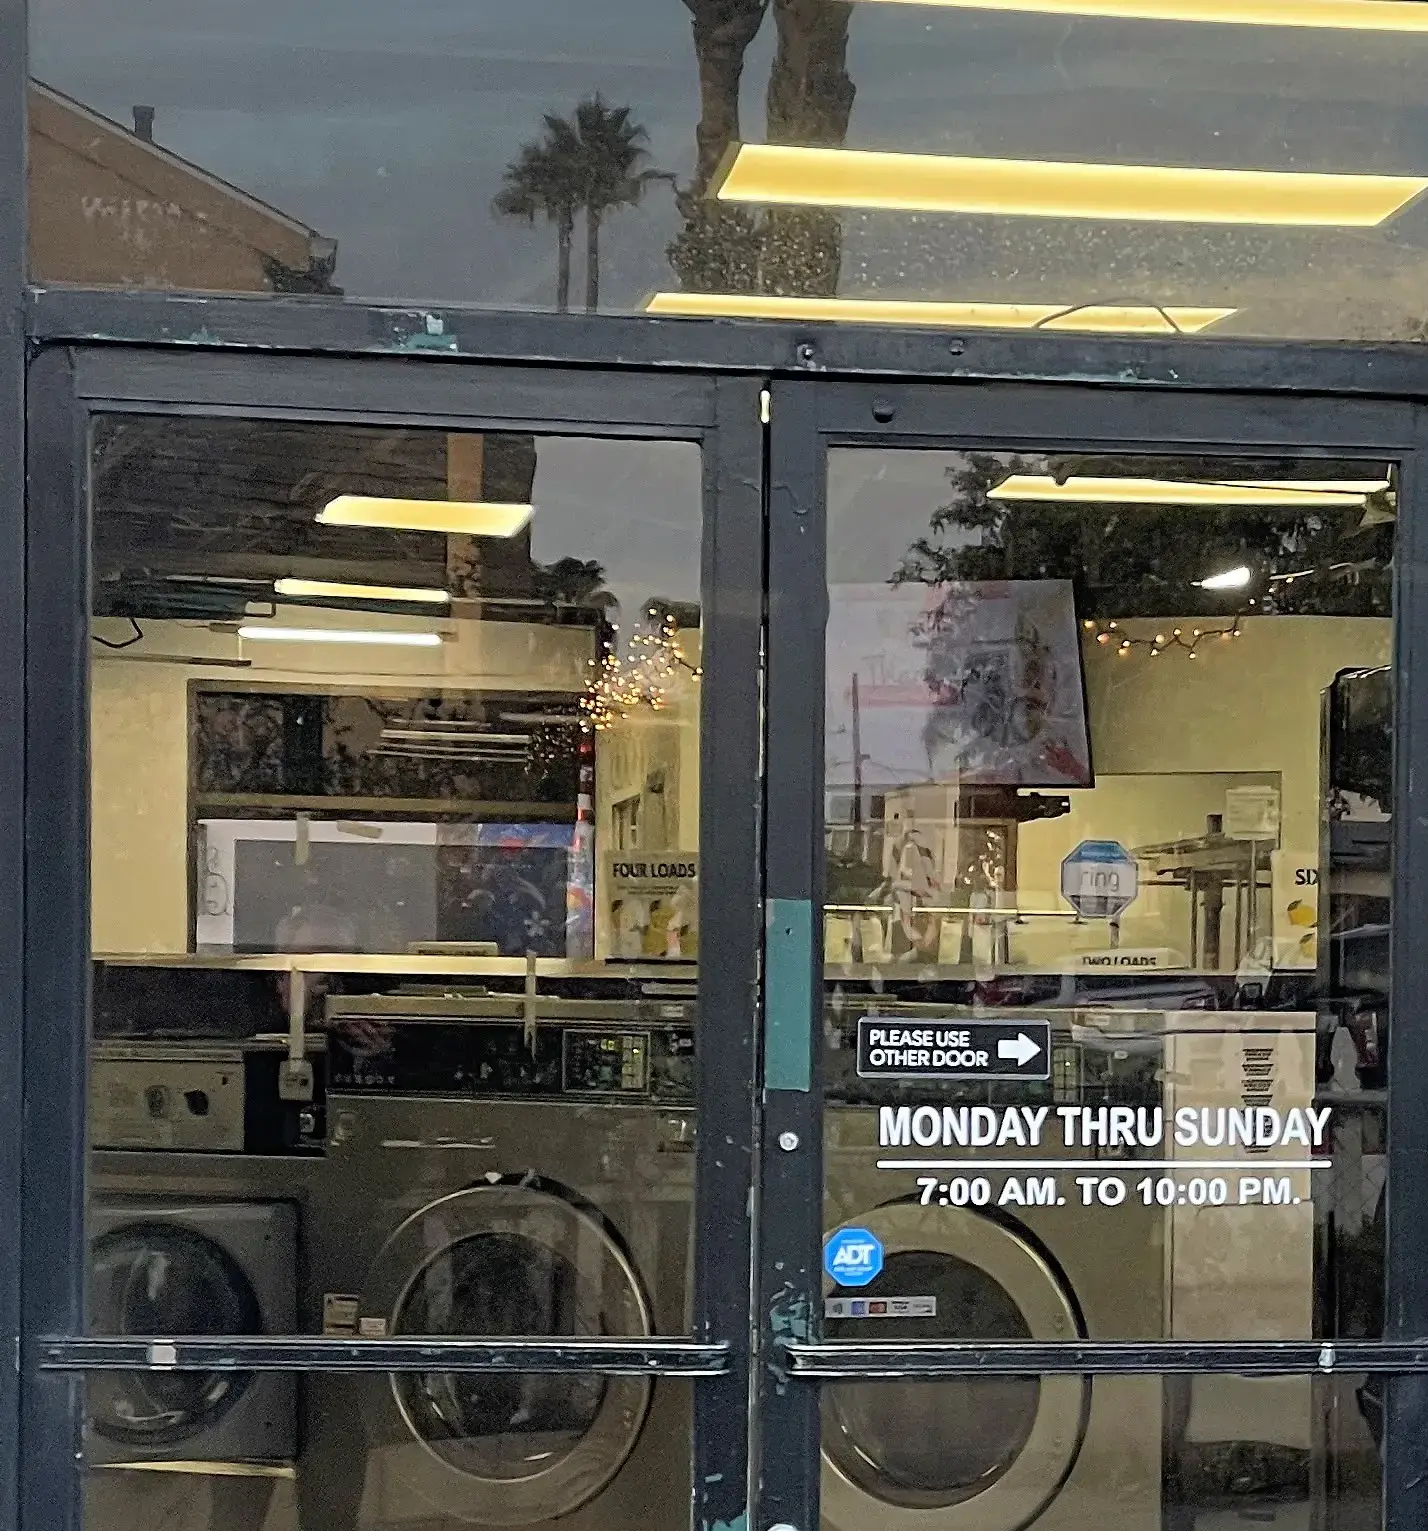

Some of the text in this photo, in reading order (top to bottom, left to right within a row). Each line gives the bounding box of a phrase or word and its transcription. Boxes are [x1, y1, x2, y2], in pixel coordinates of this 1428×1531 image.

[612, 863, 696, 878] FOUR LOADS
[1081, 870, 1120, 892] ring
[869, 1029, 970, 1048] PLEASE USE
[869, 1048, 989, 1067] OTHER DOOR
[878, 1106, 1332, 1147] MONDAY THRU SUNDAY
[916, 1177, 1301, 1206] 7:00 AM. TO 10:00 PM.
[832, 1244, 876, 1266] ADT
